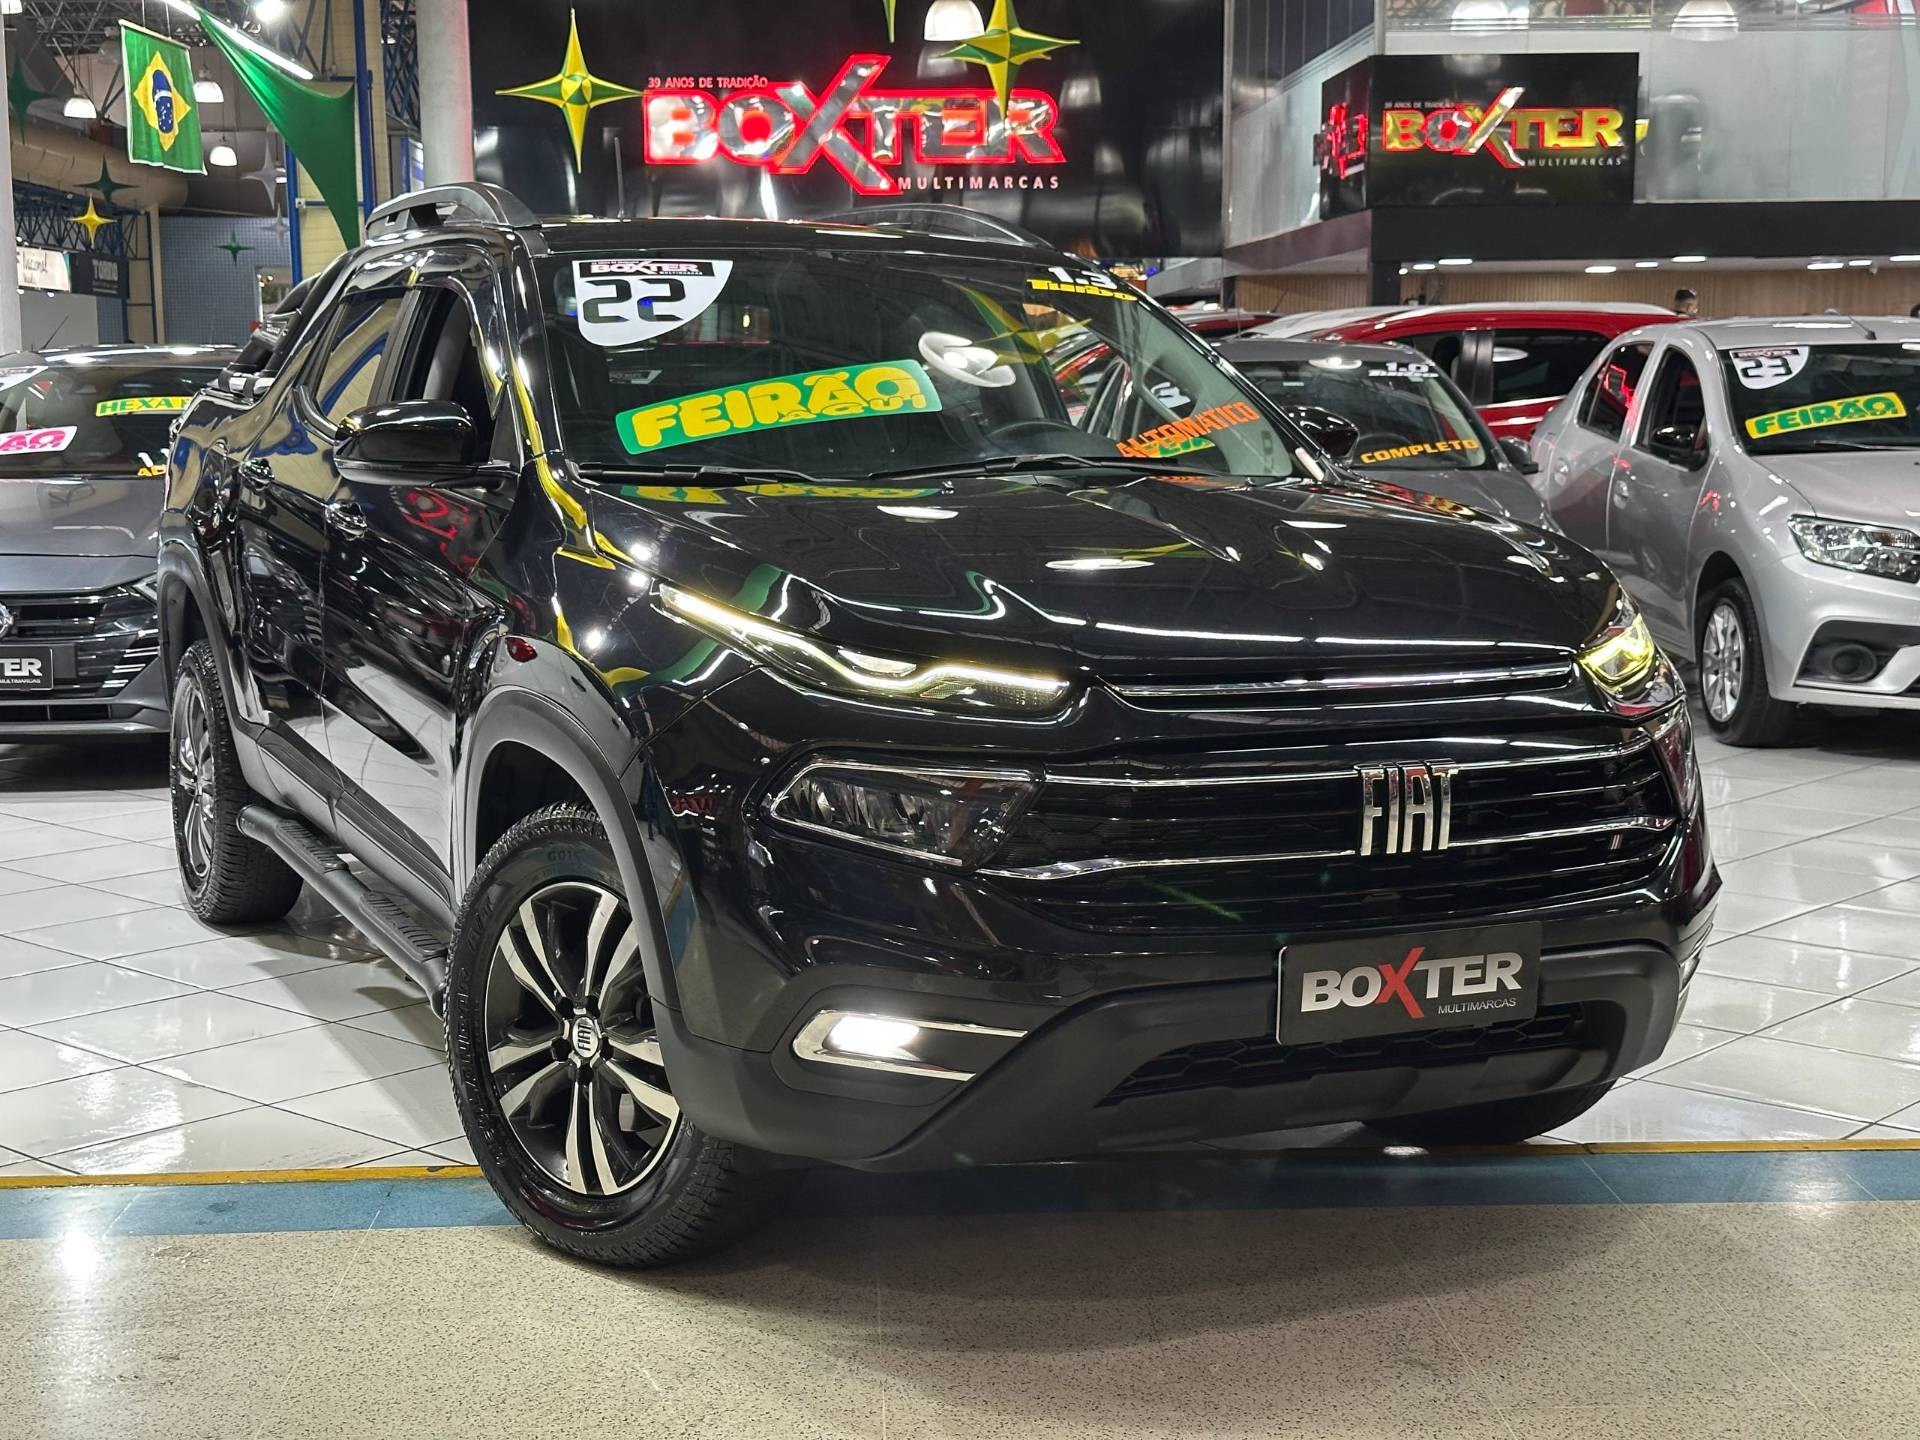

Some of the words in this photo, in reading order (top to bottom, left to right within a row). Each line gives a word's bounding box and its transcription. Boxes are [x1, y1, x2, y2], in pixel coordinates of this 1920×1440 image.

[647, 76, 661, 89] 39
[665, 77, 695, 89] ANOS
[698, 77, 713, 89] DE
[716, 74, 769, 90] TRADIÇÃO
[643, 54, 1067, 195] BOXTER
[1382, 86, 1626, 169] BOXTER
[1528, 157, 1623, 167] MULTIMARCAS
[898, 176, 1060, 190] MULTIMARCAS
[591, 260, 700, 275] BOXTER
[1048, 266, 1117, 289] 1.3
[582, 278, 686, 324] 22
[1027, 279, 1138, 301] Turbo
[1739, 357, 1793, 378] 23
[99, 397, 174, 414] HEXA
[632, 366, 919, 447] FEIRÃO
[1754, 396, 1896, 434] FEIRÃO
[1360, 439, 1480, 465] COMPLETO
[1354, 759, 1458, 856] FIAT
[1300, 946, 1523, 1018] BOXTER
[1438, 997, 1517, 1015] MULTIMARCAS
[578, 1024, 591, 1051] FIAT
